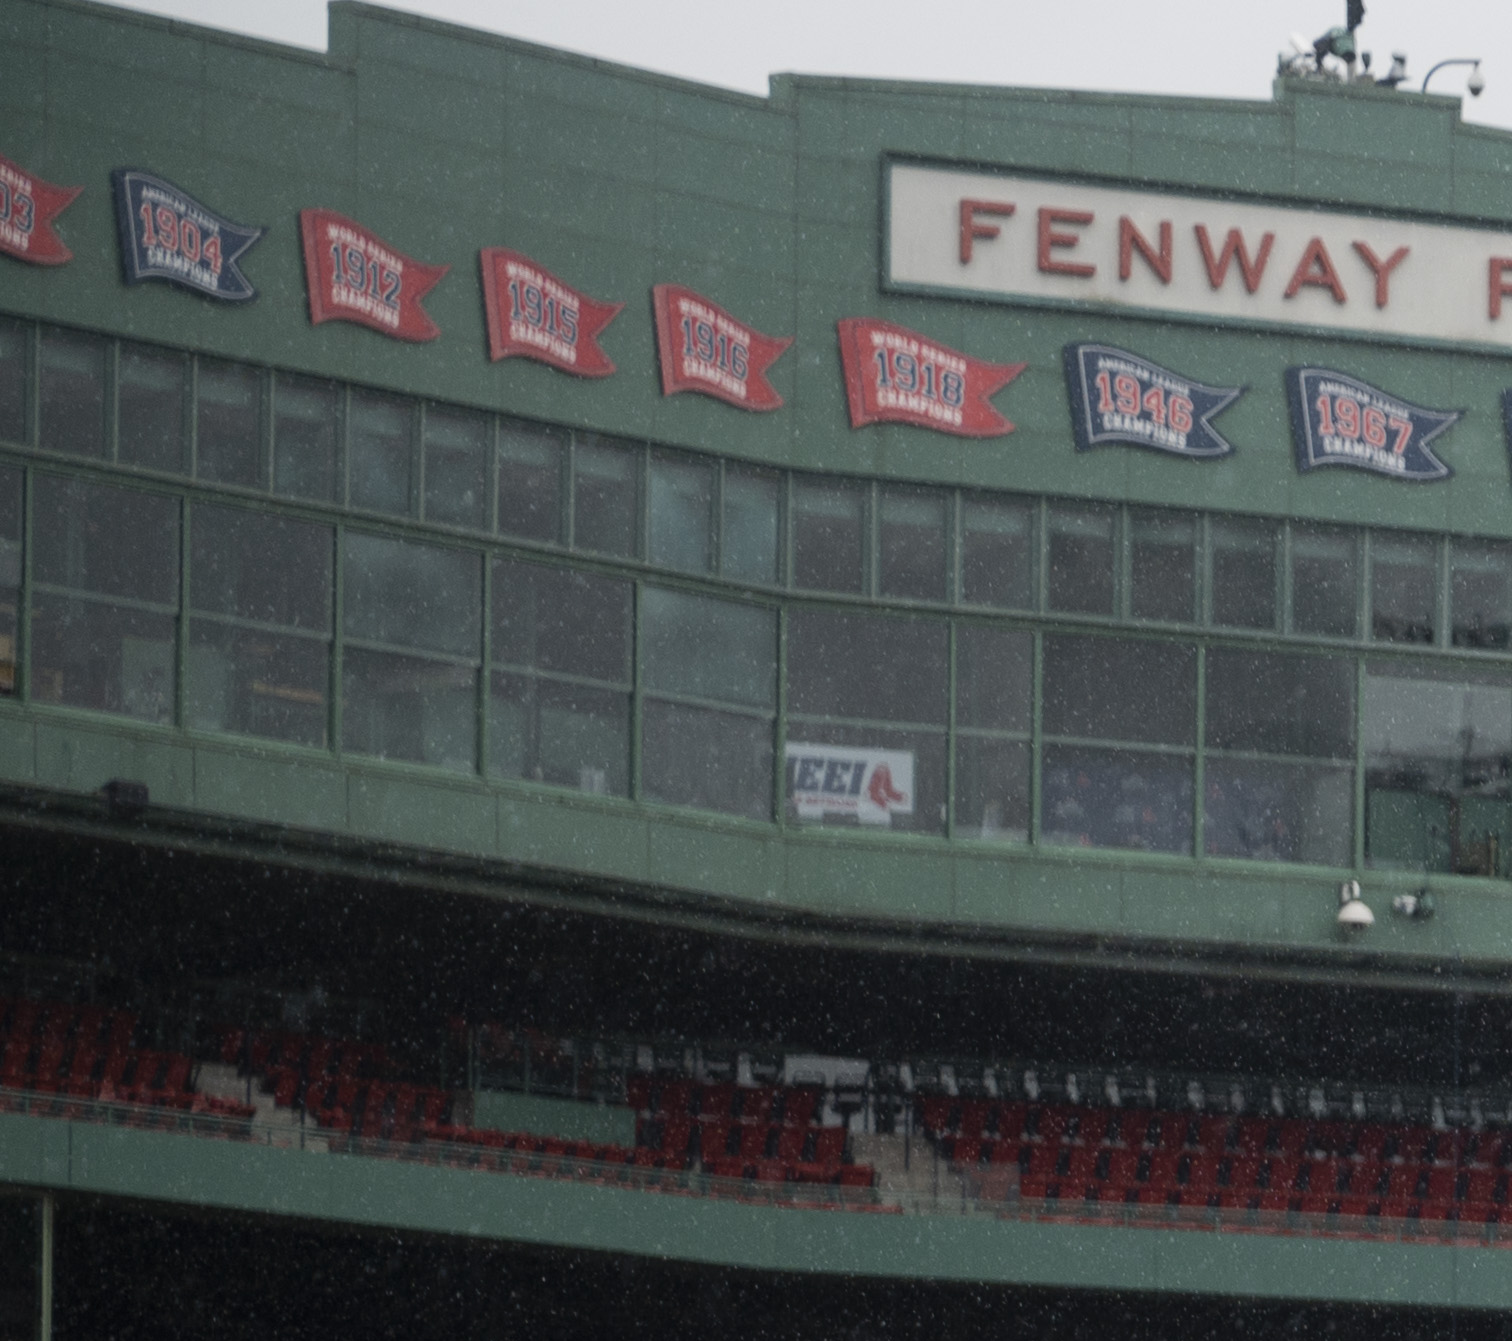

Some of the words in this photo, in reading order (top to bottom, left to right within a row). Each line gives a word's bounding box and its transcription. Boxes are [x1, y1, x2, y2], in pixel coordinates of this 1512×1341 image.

[140, 202, 223, 275] 1904
[960, 197, 1412, 310] FENWAY
[330, 243, 403, 309] 1912
[508, 280, 579, 346] 1915
[680, 317, 749, 382] 1916
[874, 348, 965, 408] 1918
[1096, 371, 1194, 433] 1946
[1316, 395, 1413, 455] 1967
[787, 757, 867, 794] EEI
